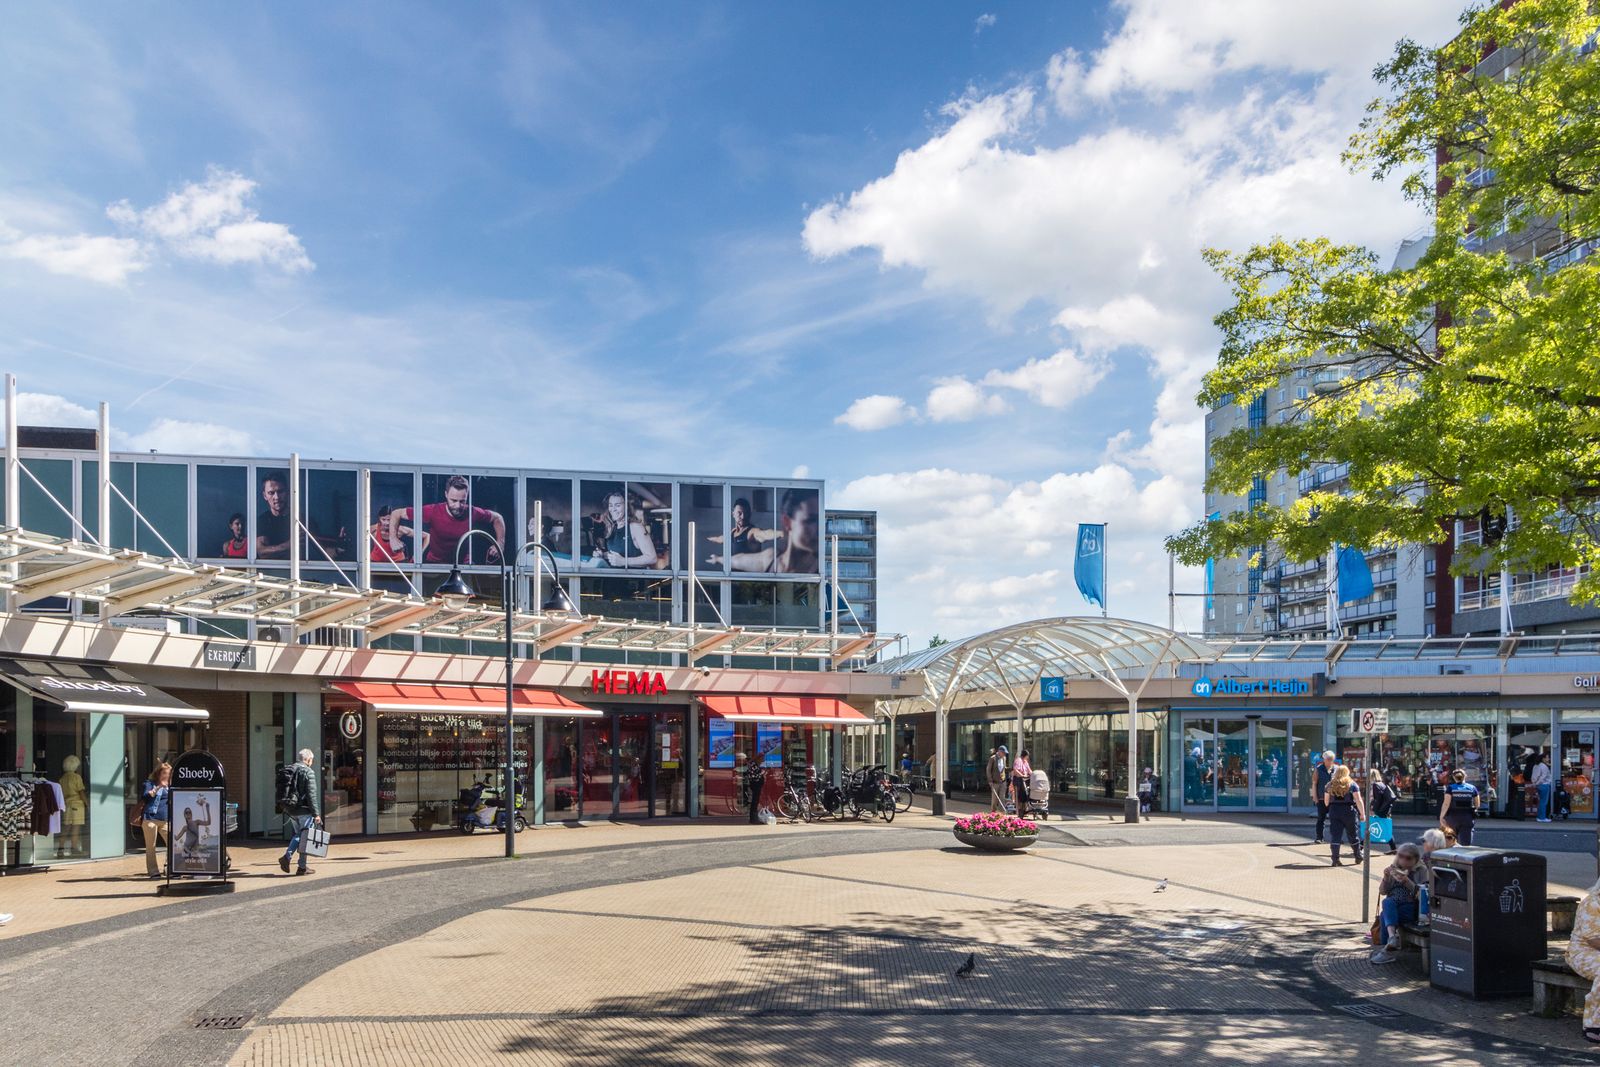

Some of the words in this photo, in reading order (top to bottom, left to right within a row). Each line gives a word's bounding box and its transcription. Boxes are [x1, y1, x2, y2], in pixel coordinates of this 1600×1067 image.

[208, 649, 246, 663] EXERCISE
[592, 669, 668, 696] HEMA
[1215, 679, 1266, 695] Albert
[1268, 679, 1308, 696] Heijn
[1574, 676, 1598, 688] Gall
[383, 762, 404, 770] koffie
[178, 767, 215, 781] Shoeby
